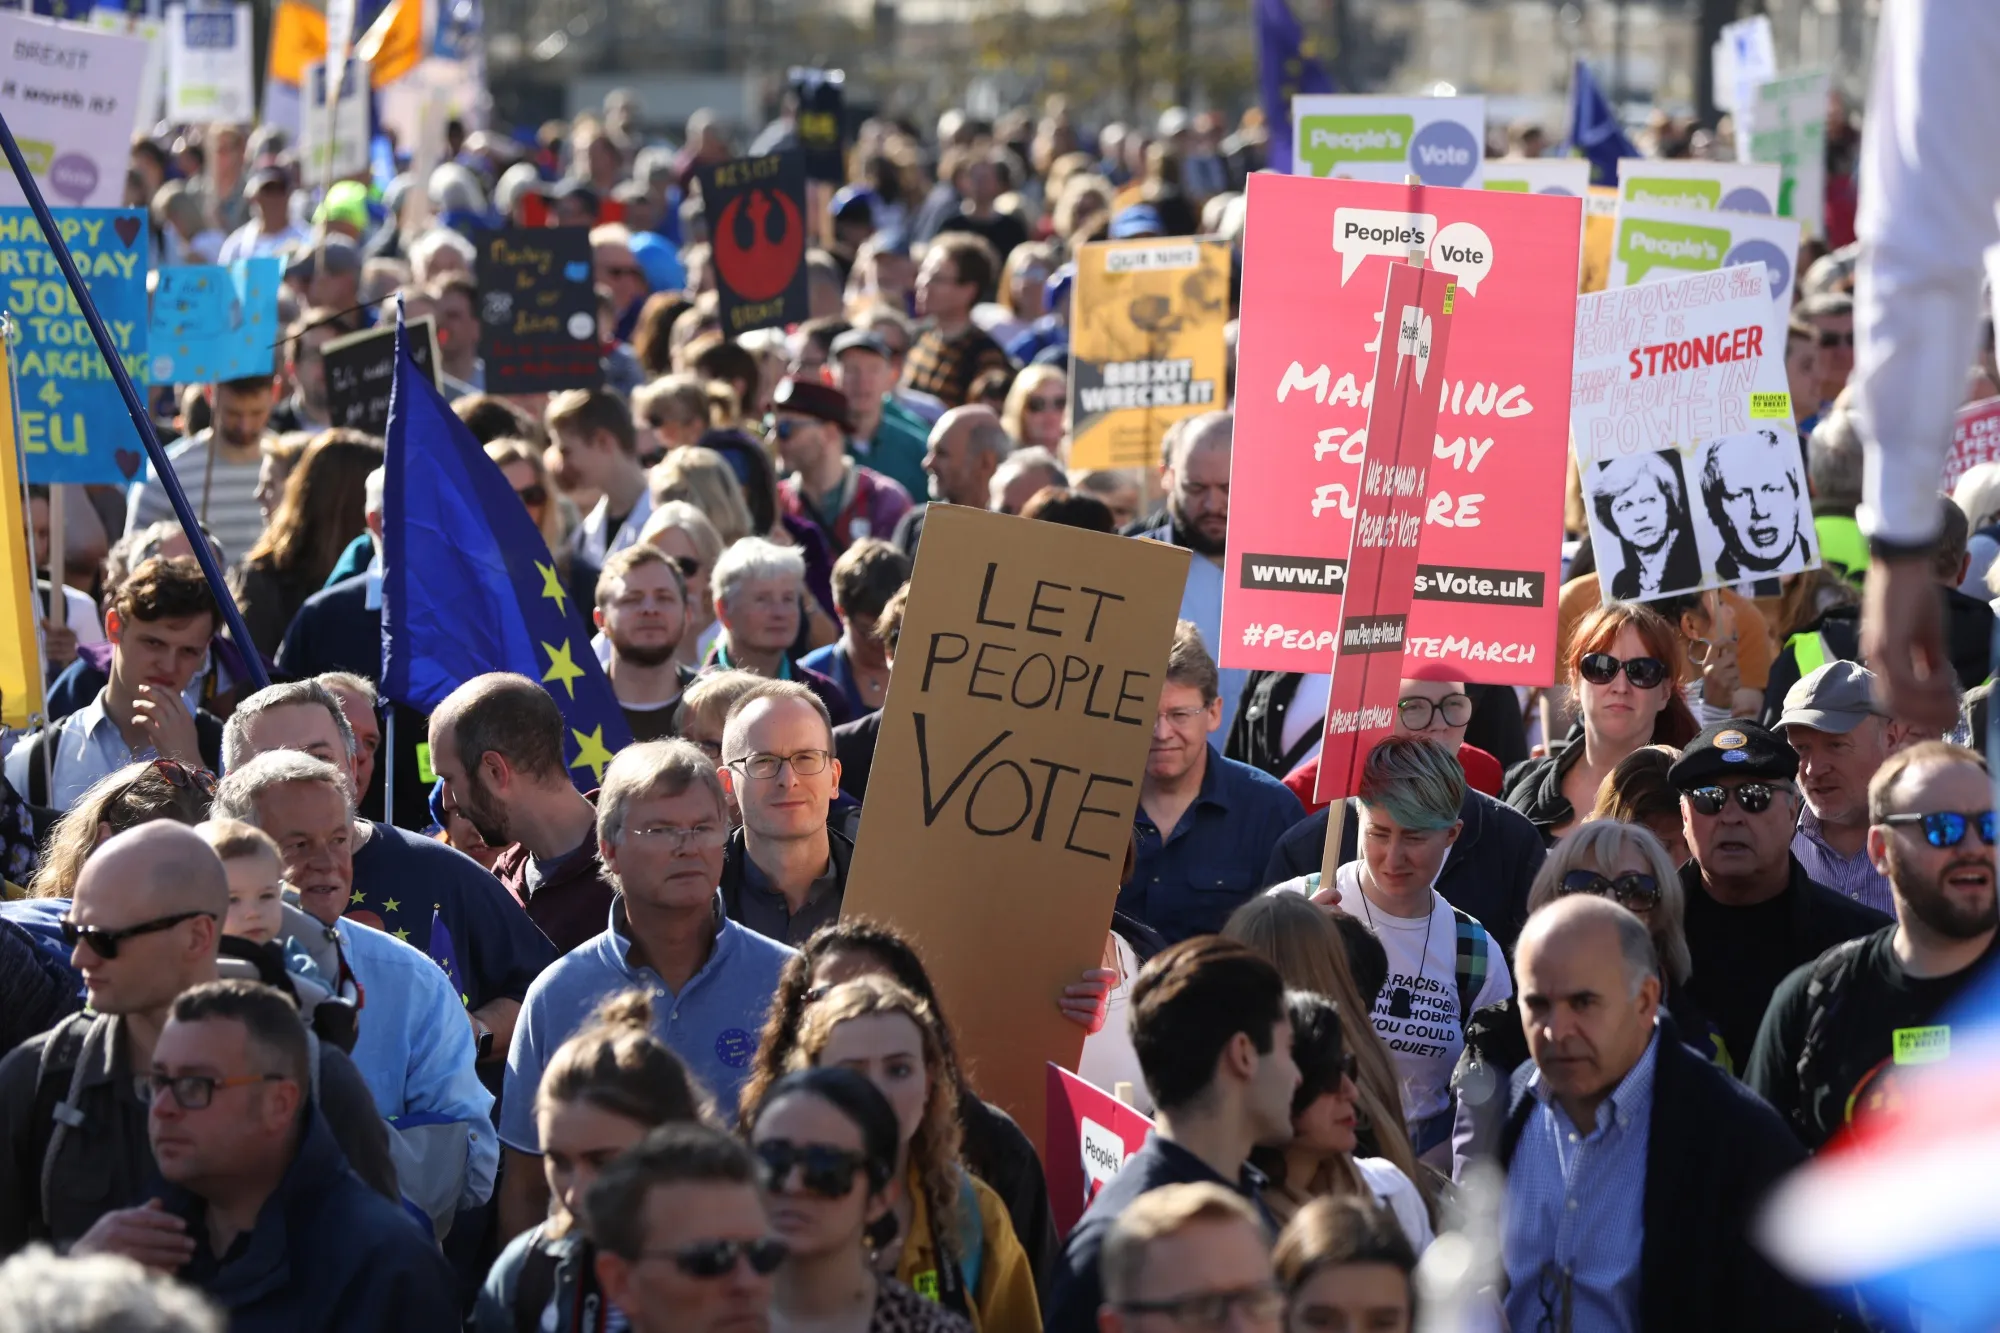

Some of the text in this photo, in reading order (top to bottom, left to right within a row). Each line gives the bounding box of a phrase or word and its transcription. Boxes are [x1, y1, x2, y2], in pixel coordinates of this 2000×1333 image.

[1310, 128, 1469, 165] People's Vote
[1109, 250, 1147, 270] OUR
[1344, 222, 1484, 264] People's Vote
[1631, 231, 1717, 261] People's
[1729, 277, 1762, 300] THE
[1732, 267, 1751, 283] OF
[1619, 272, 1726, 320] POWER
[1401, 320, 1429, 359] People's Vote
[1665, 313, 1685, 338] IS
[1628, 324, 1764, 381] STRONGER
[1103, 359, 1193, 385] BREXIT
[1608, 368, 1711, 417] PEOPLE
[1718, 358, 1760, 396] IN
[38, 381, 64, 408] 4
[1080, 380, 1214, 412] WRECKS IT
[22, 412, 88, 455] EU
[1313, 427, 1367, 465] FO
[1589, 394, 1747, 460] POWER
[1365, 458, 1426, 498] WE DEMAND A
[1356, 508, 1421, 548] PEOPLE'S VOTE
[976, 562, 1126, 643] LET
[1343, 621, 1403, 649] www.Peoples-Vote.uk
[920, 632, 1150, 726] PEOPLE
[912, 712, 1134, 862] VOTE
[1389, 1038, 1447, 1058] QUIET?
[1404, 1023, 1455, 1042] COULD
[1085, 1136, 1119, 1174] People's
